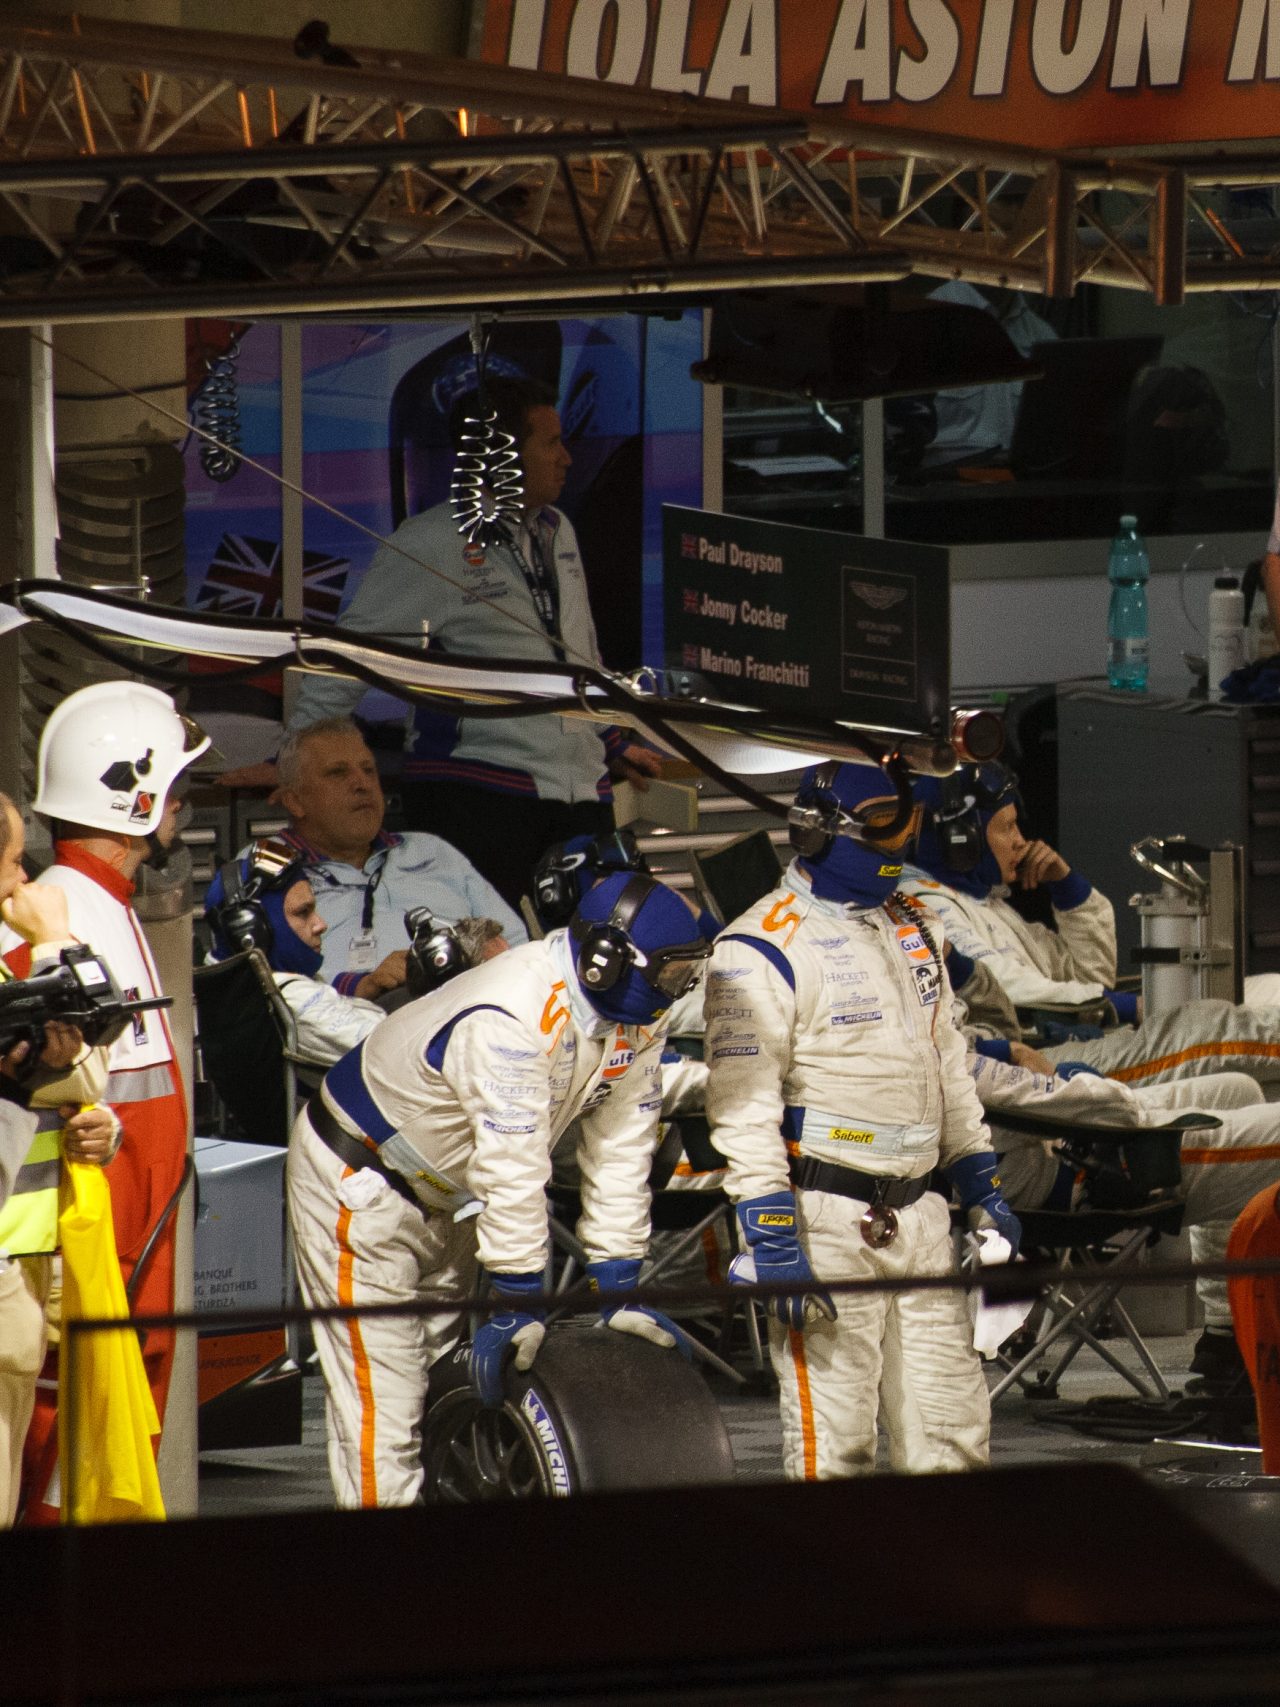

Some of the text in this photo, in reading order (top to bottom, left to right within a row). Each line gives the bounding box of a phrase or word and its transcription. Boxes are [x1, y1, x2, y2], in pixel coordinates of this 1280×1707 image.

[699, 537, 783, 574] Paul Drayson
[701, 593, 789, 630] Jonny Cocker
[701, 647, 810, 688] Marino Franchitti
[901, 936, 925, 951] Gul
[844, 1011, 882, 1023] MICHELIN
[609, 1052, 634, 1067] ulf
[483, 1080, 539, 1095] HACKETT
[832, 1129, 872, 1144] Sabelt
[210, 1280, 257, 1295] BROTHERS
